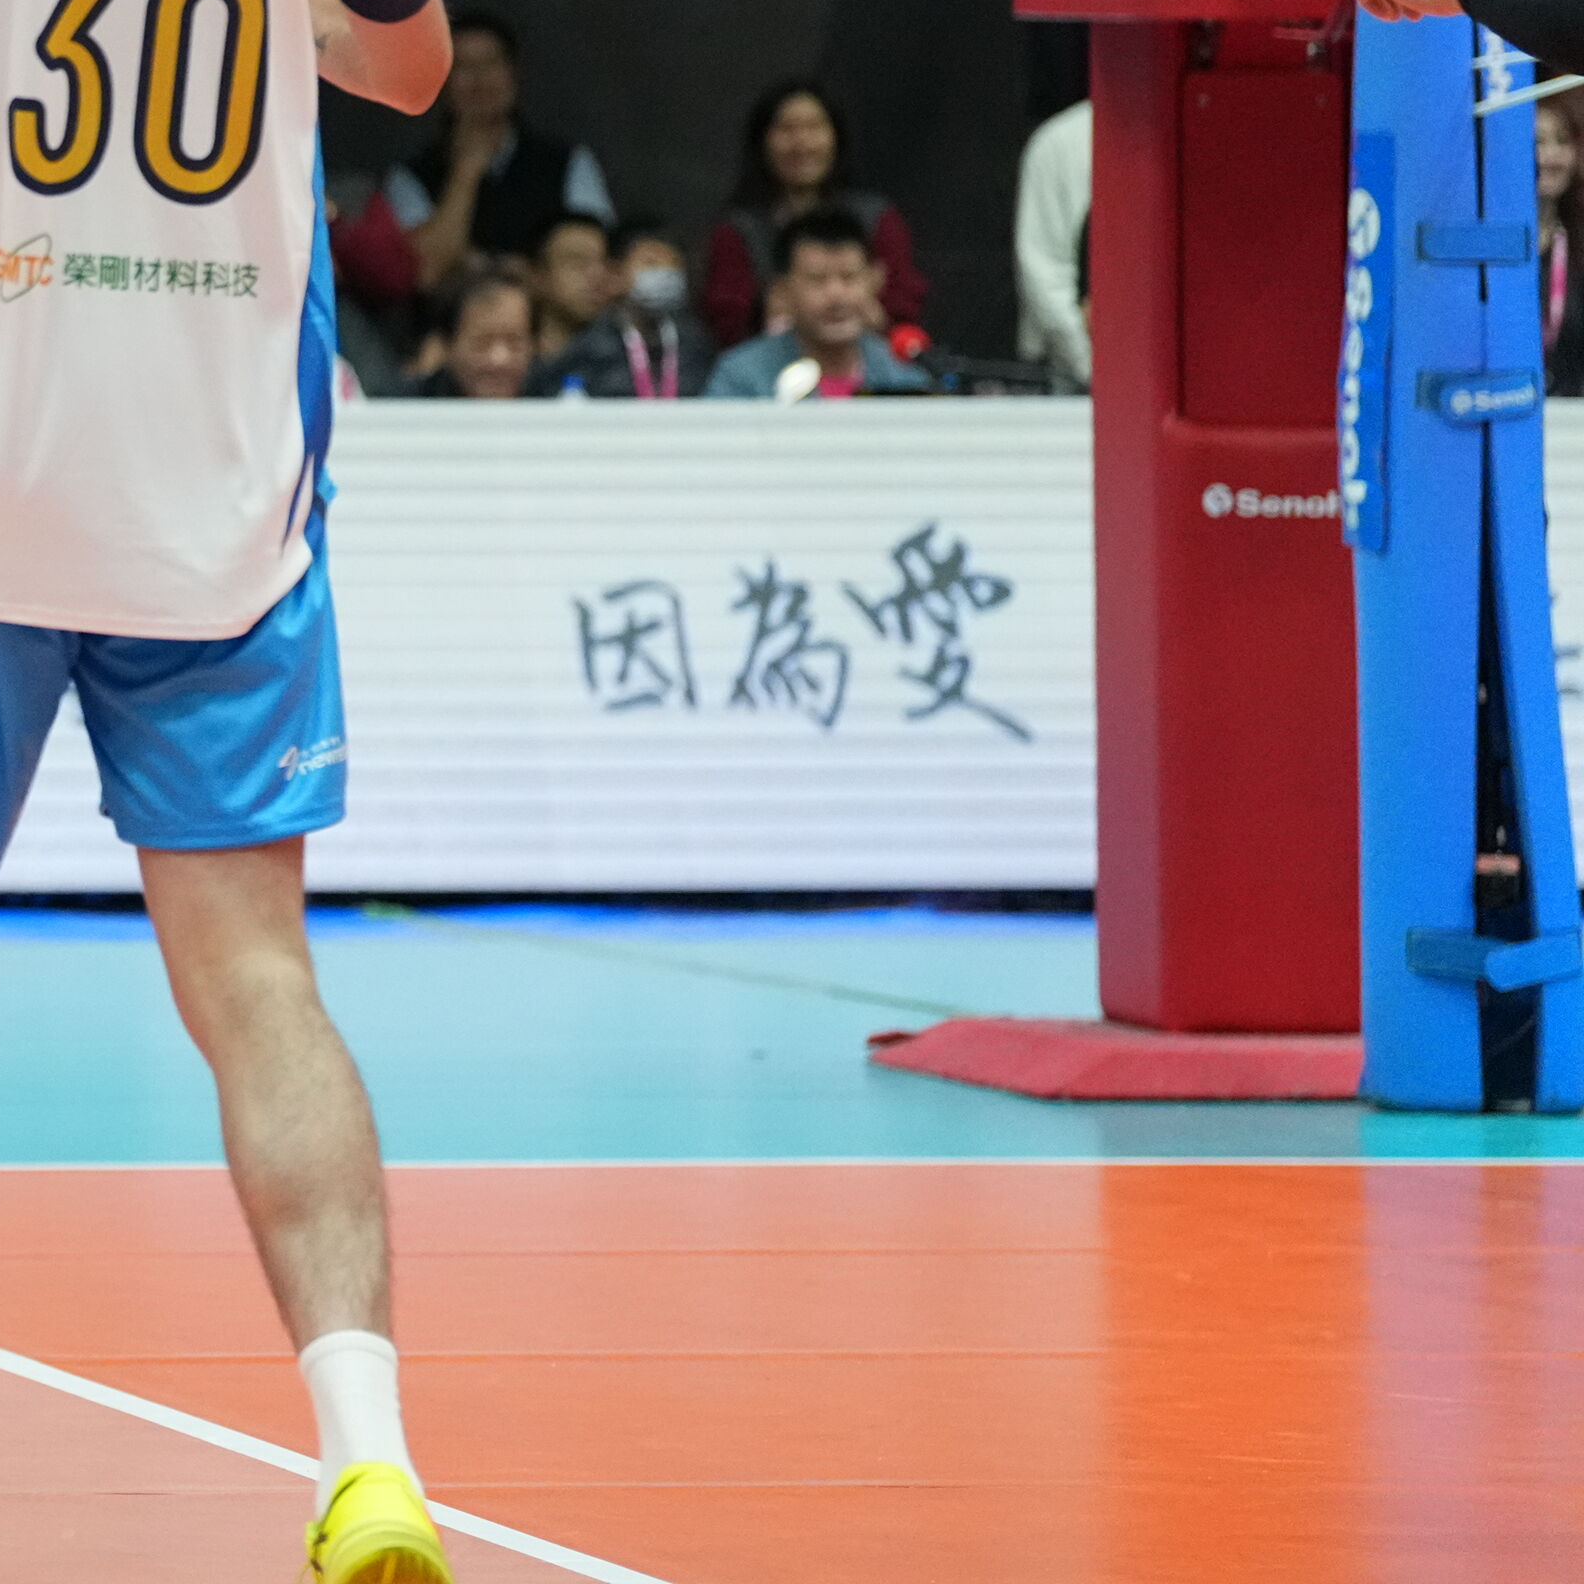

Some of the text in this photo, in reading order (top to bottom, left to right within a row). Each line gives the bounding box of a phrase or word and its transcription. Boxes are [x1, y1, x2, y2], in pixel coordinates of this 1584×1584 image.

[62, 252, 260, 298] 榮剛材料科技
